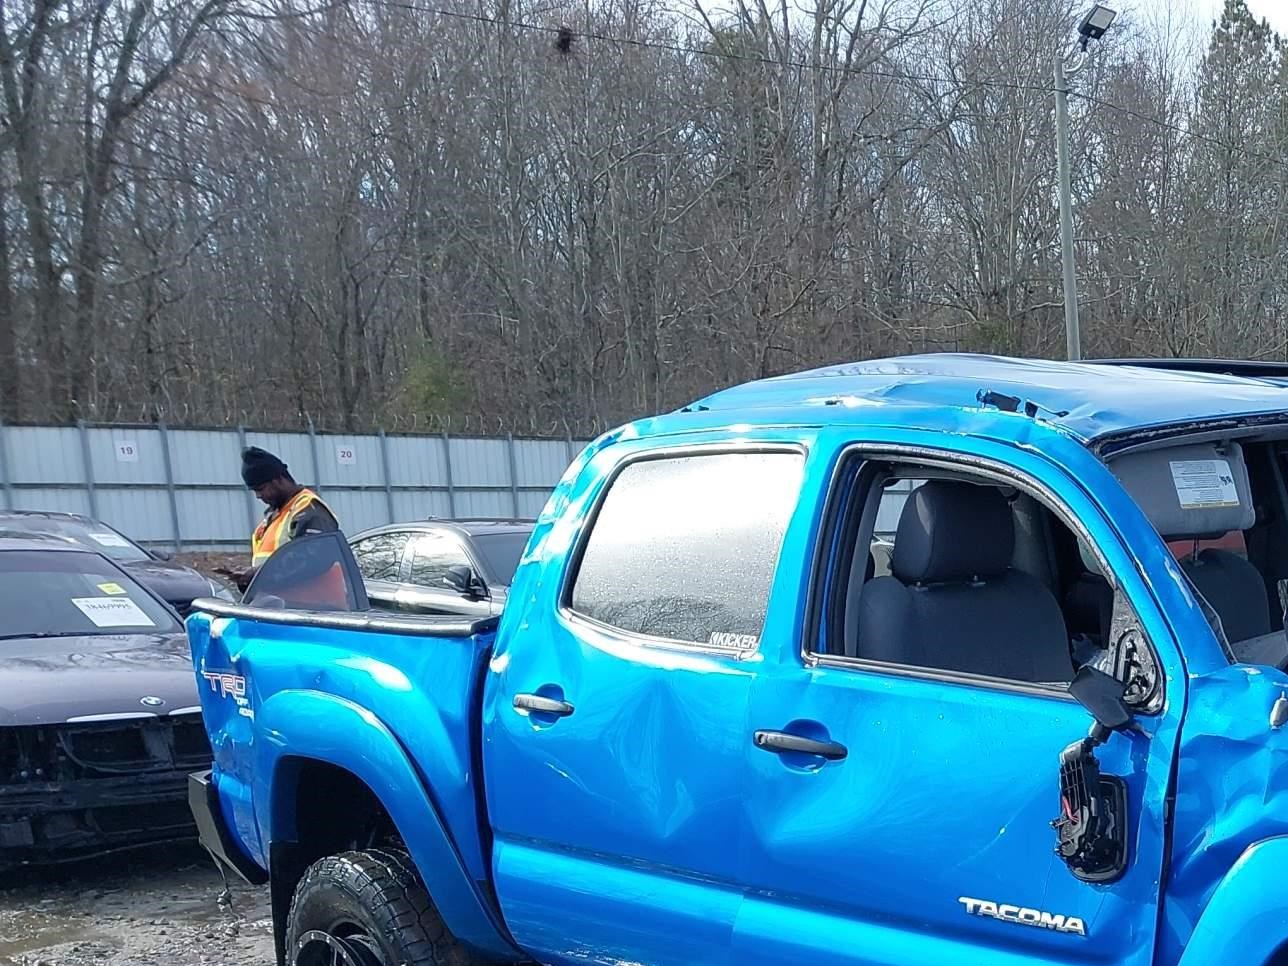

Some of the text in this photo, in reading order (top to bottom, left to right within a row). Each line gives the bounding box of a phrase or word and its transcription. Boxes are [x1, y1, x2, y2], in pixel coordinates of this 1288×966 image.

[120, 446, 133, 455] 19
[340, 450, 352, 459] 20
[712, 632, 757, 648] KICKER
[203, 671, 245, 699] TRD
[958, 896, 1086, 935] TACOMA
